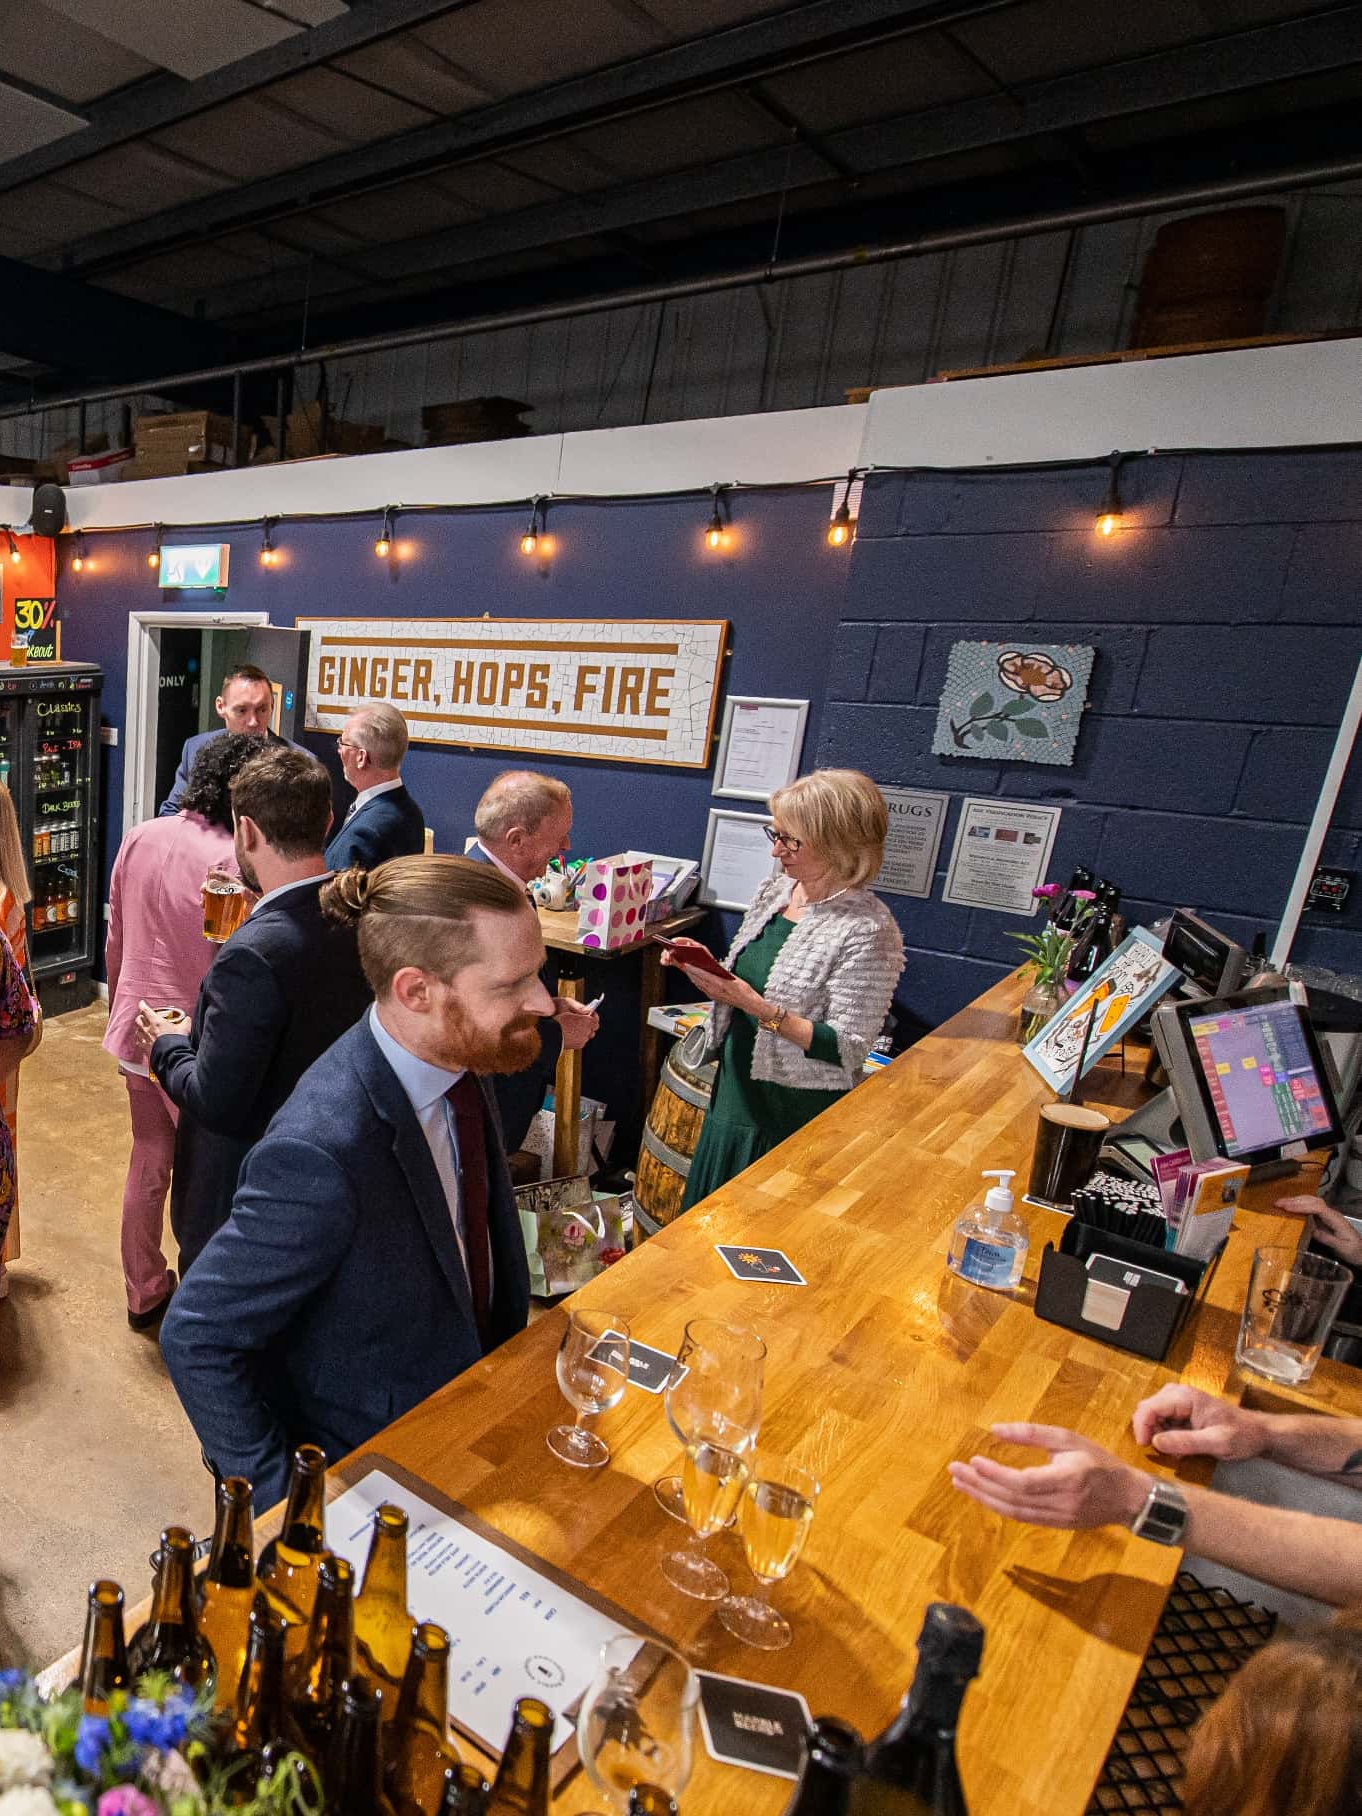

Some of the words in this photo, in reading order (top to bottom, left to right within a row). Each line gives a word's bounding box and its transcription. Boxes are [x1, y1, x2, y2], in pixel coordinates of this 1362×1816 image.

[15, 599, 56, 630] 30%
[26, 643, 54, 658] keout
[159, 675, 185, 687] ONLY
[318, 656, 440, 706] GINGER,
[451, 660, 561, 714] HOPS,
[574, 665, 675, 717] FIRE
[888, 802, 933, 818] RUGS
